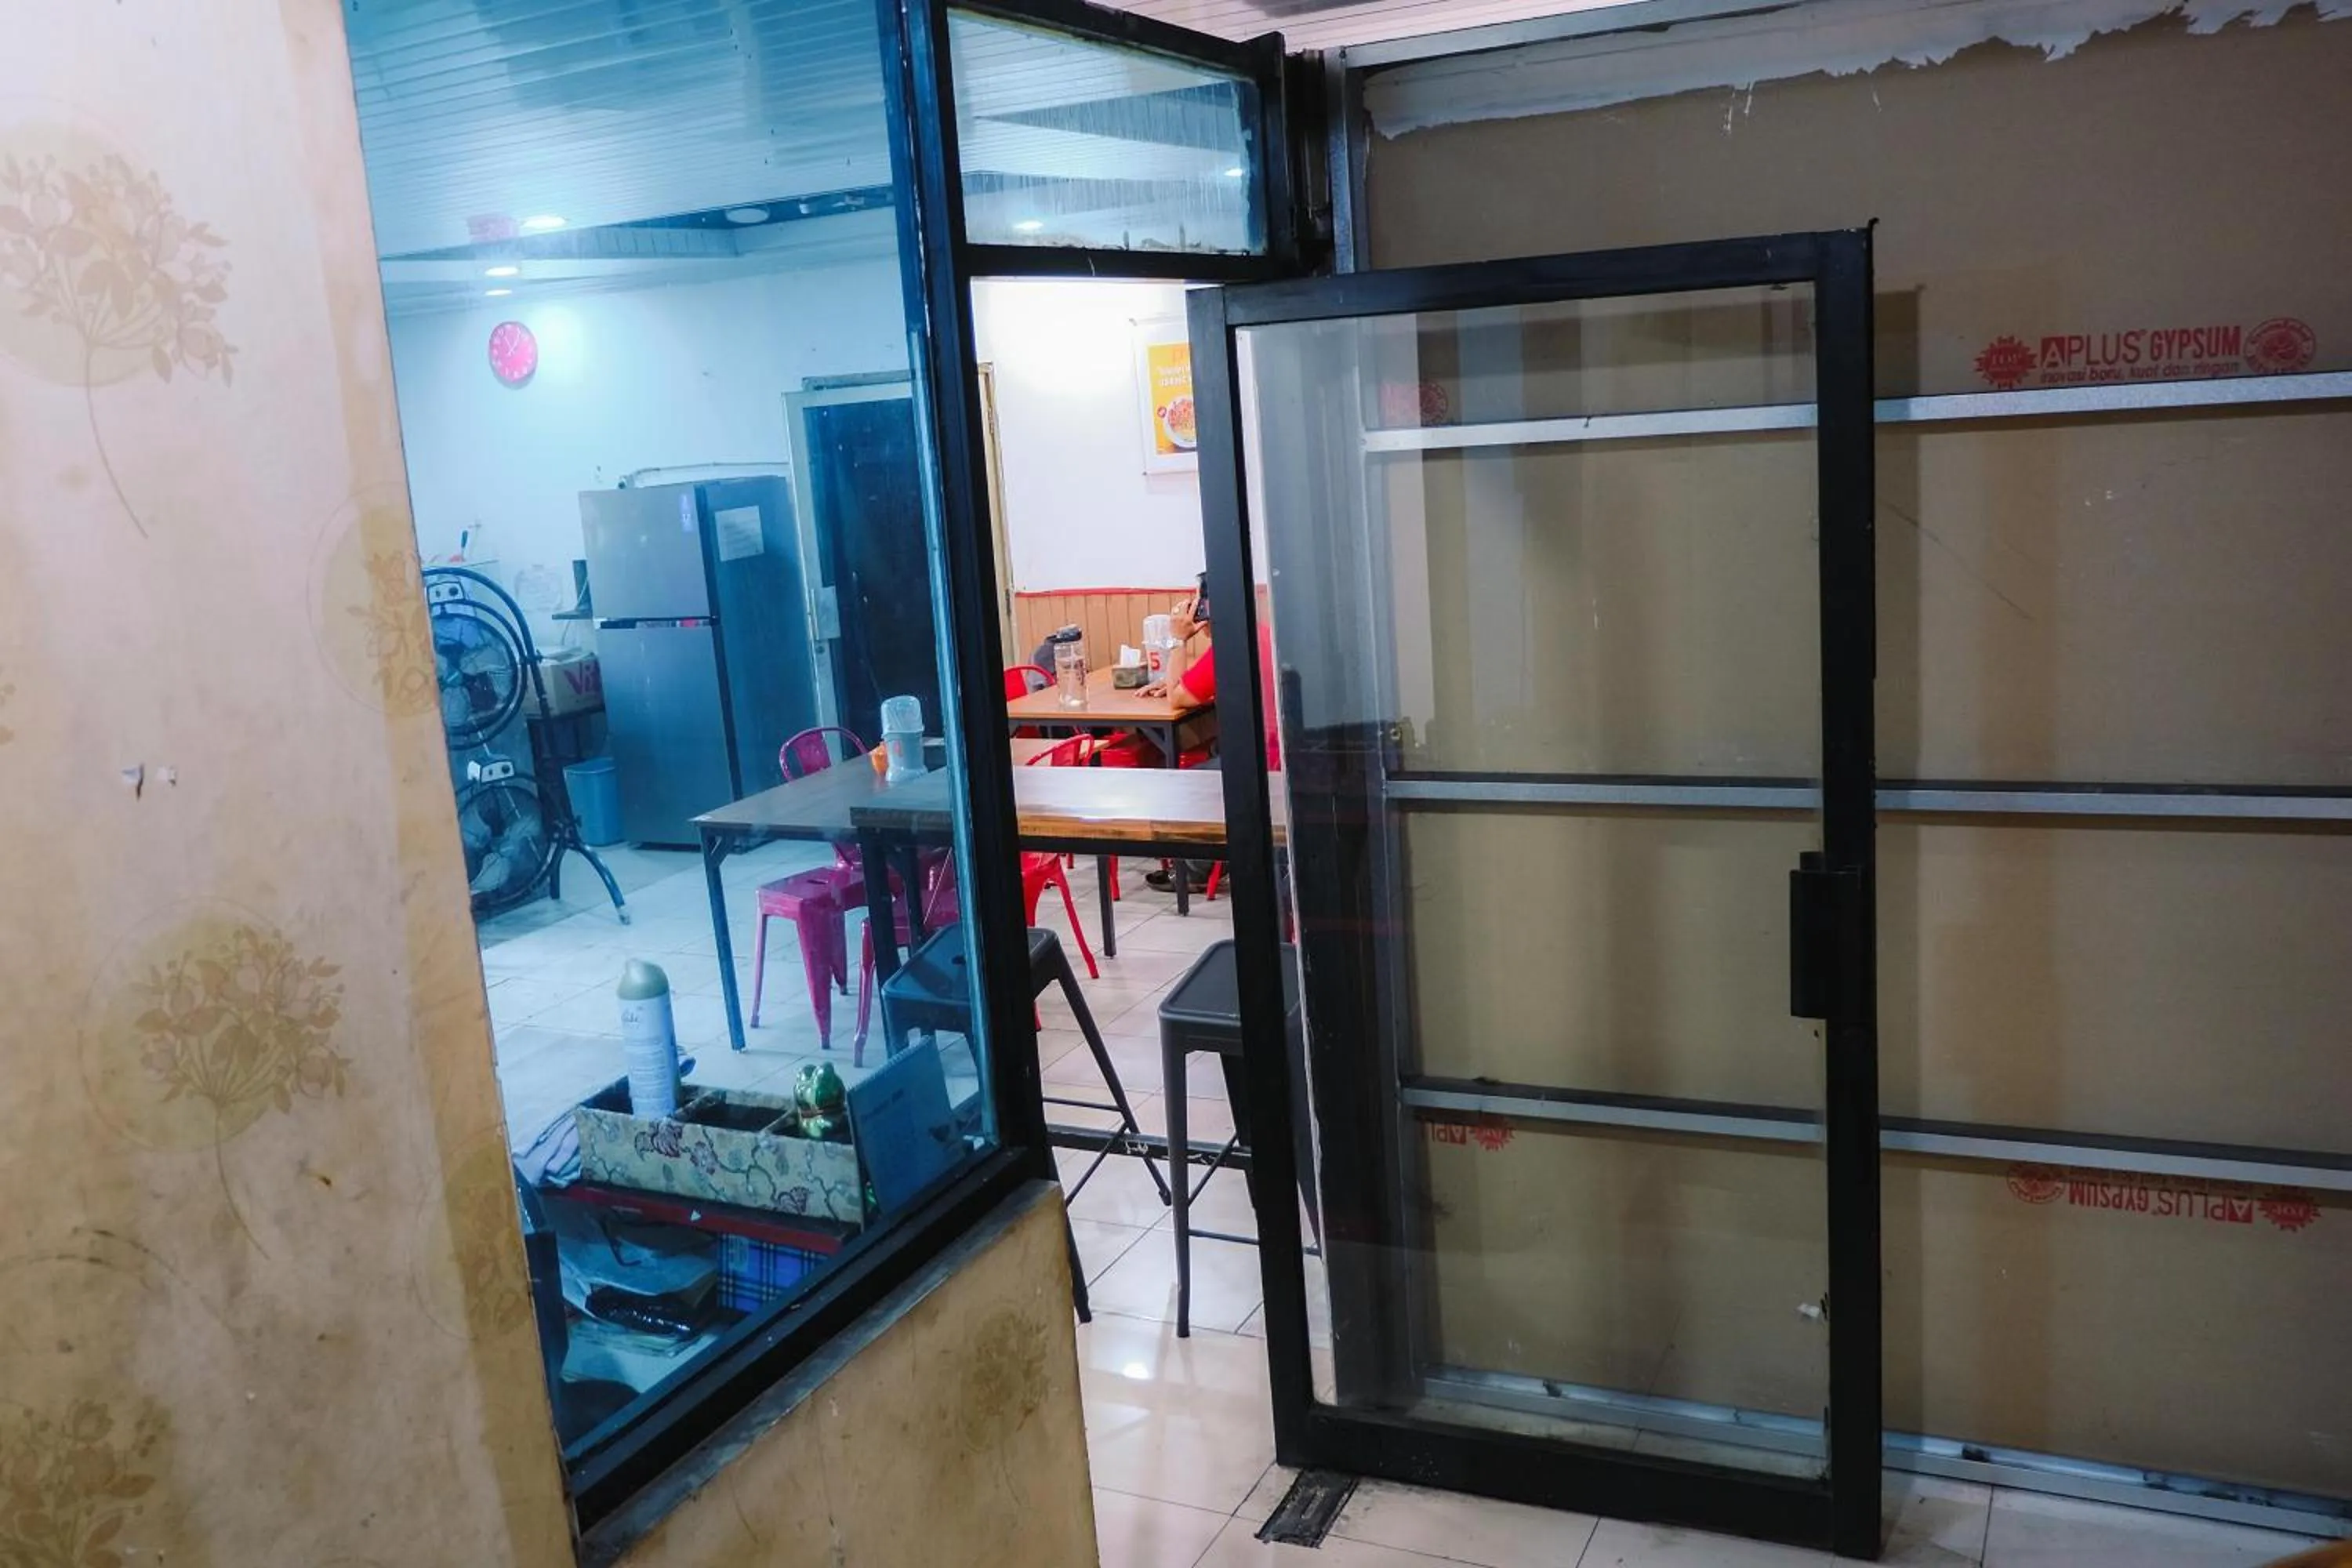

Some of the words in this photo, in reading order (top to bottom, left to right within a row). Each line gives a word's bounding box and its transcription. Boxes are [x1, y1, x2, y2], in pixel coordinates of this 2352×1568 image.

[2041, 330, 2141, 369] APLUS
[2150, 325, 2241, 361] GYPSUM
[1150, 652, 1160, 670] 5
[2068, 1182, 2150, 1214] GYPSUM
[2157, 1189, 2253, 1223] APLUS
